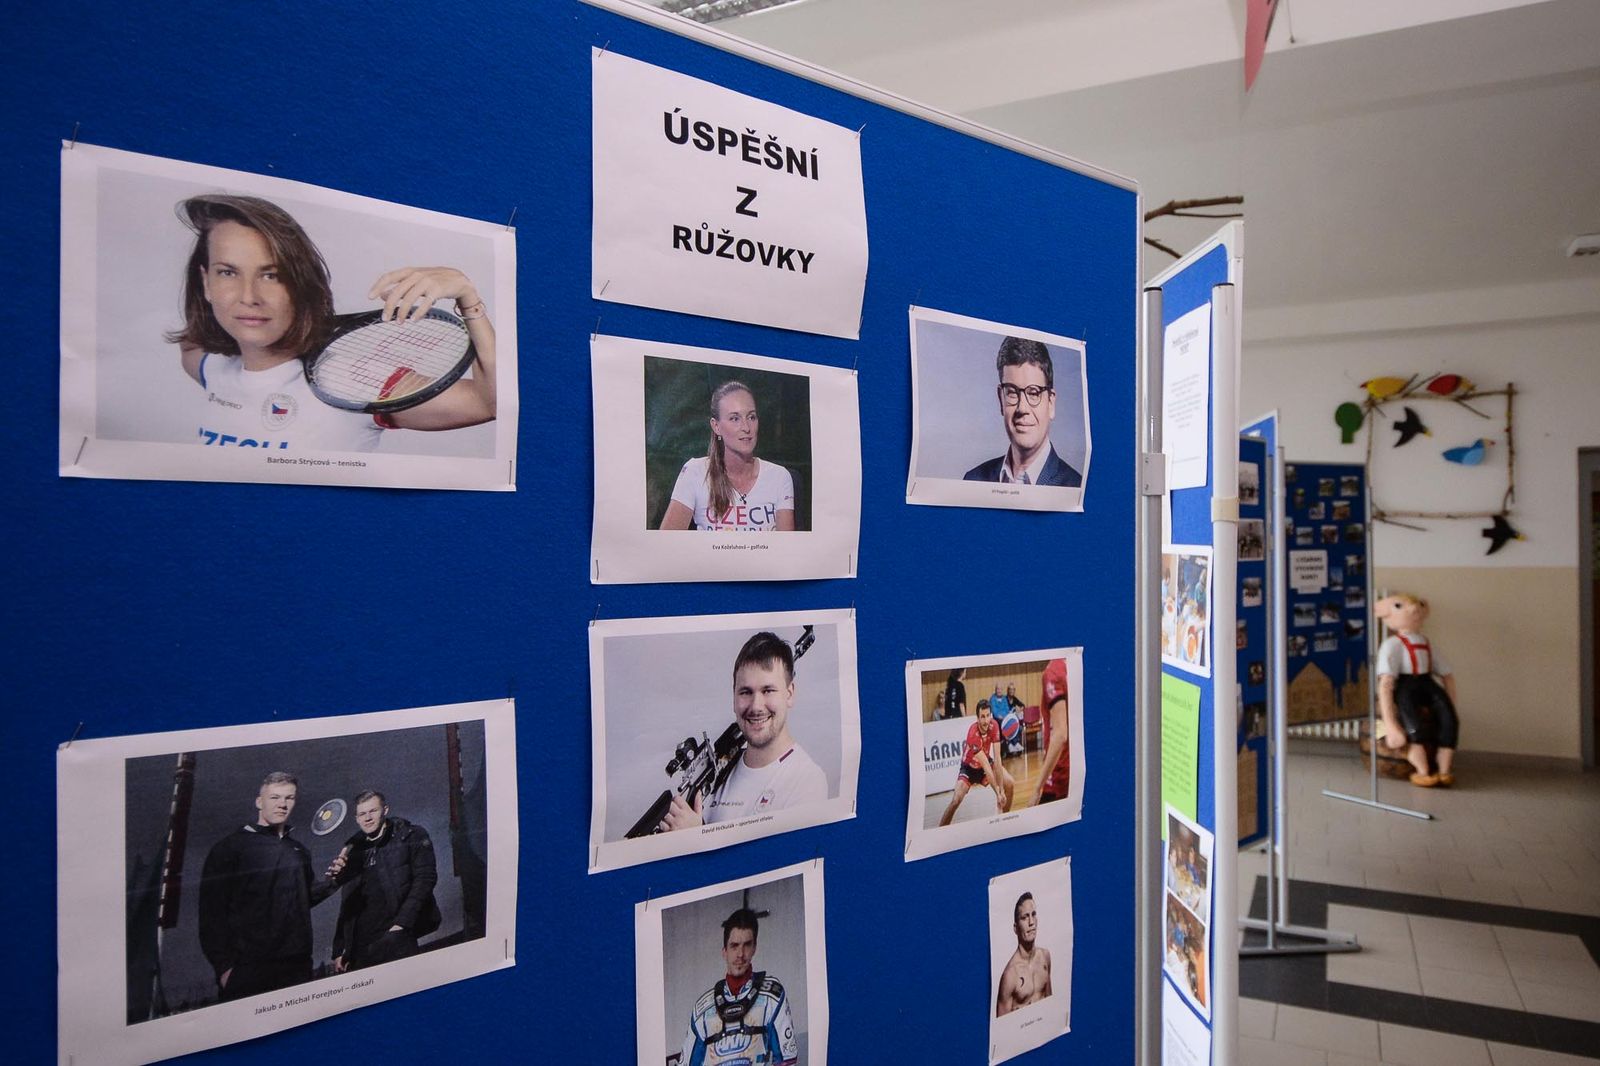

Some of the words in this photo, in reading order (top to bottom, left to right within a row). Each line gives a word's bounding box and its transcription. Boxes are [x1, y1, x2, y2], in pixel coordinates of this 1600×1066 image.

[663, 107, 819, 181] ÚSPĚŠNÍ
[735, 185, 758, 218] Z
[672, 222, 815, 274] RŮŽOVKY
[267, 456, 298, 465] Barbora
[298, 457, 330, 467] Strýcová
[338, 459, 367, 468] tenistka
[701, 826, 715, 834] David
[254, 1003, 277, 1015] Jakub
[284, 995, 310, 1007] Michal
[311, 986, 344, 1000] Forejtovi
[351, 978, 375, 990] diskaři
